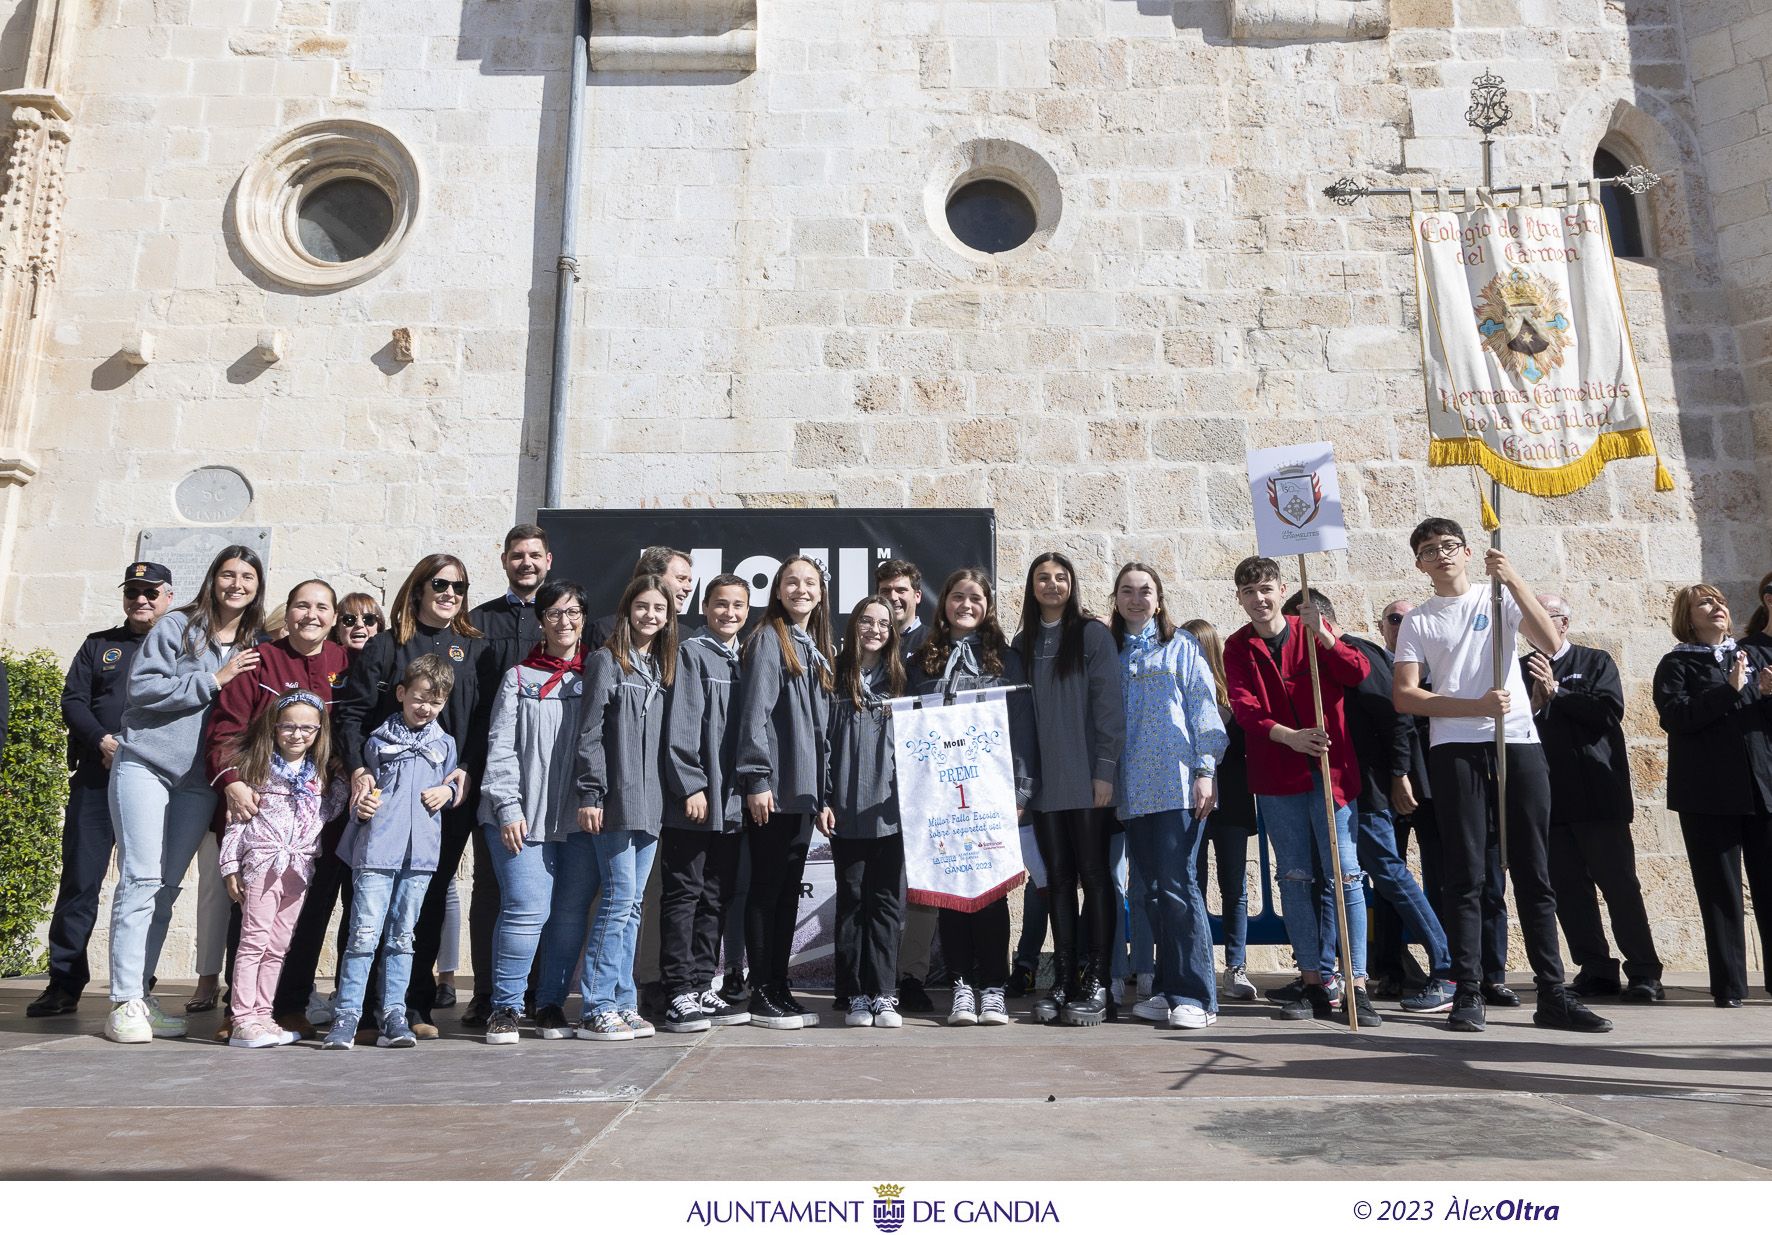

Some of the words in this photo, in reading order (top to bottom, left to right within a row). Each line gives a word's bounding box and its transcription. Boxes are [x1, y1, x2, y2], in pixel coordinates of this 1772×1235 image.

[1420, 216, 1492, 248] Colegio
[1498, 216, 1519, 239] de
[1525, 215, 1562, 242] Ntra
[1564, 214, 1600, 238] Sra
[1456, 245, 1486, 266] del
[1505, 241, 1581, 265] Carmen
[1438, 387, 1530, 413] Hermanas
[1533, 381, 1631, 409] Carmelitas
[1465, 411, 1488, 433] de
[1494, 411, 1513, 431] la
[1522, 404, 1613, 435] Caridad
[1502, 434, 1581, 462] Gandia
[939, 765, 980, 783] PREMI
[955, 783, 970, 809] 1
[928, 815, 950, 828] Millor
[951, 813, 971, 824] Falla
[973, 810, 1001, 821] Escolar
[952, 823, 988, 837] seguretat
[944, 863, 974, 875] GANDIA
[975, 861, 993, 871] 2023
